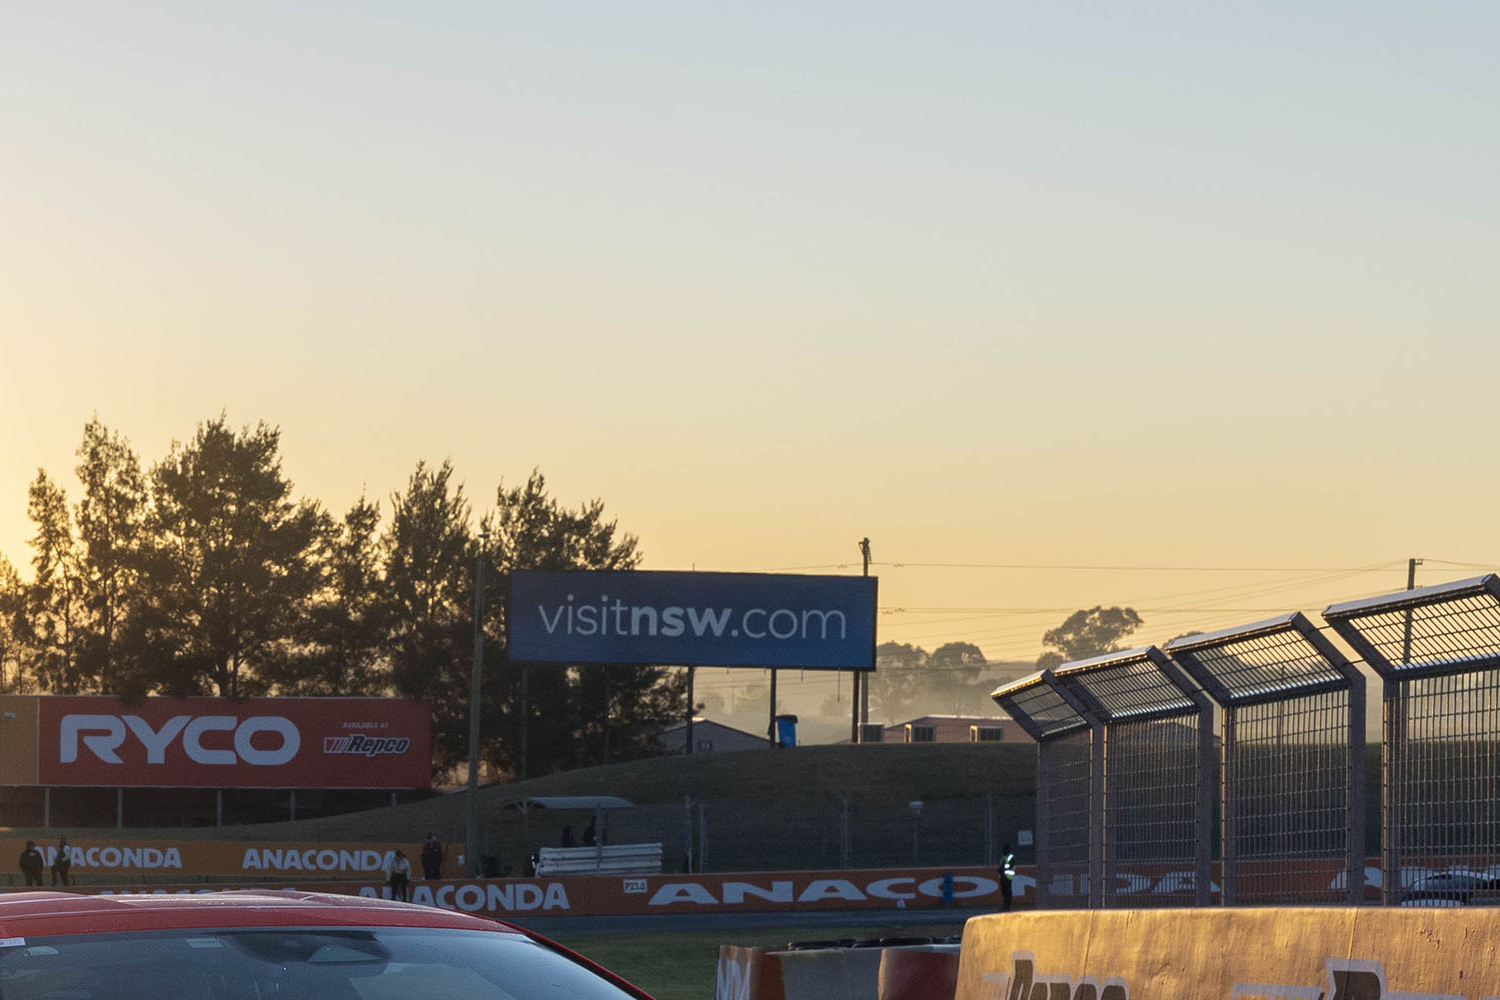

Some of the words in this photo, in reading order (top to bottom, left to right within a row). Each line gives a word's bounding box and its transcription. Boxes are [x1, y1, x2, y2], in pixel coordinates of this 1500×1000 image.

[538, 594, 847, 640] visitnsw.com
[60, 714, 301, 766] RYCO
[346, 733, 411, 758] Repco
